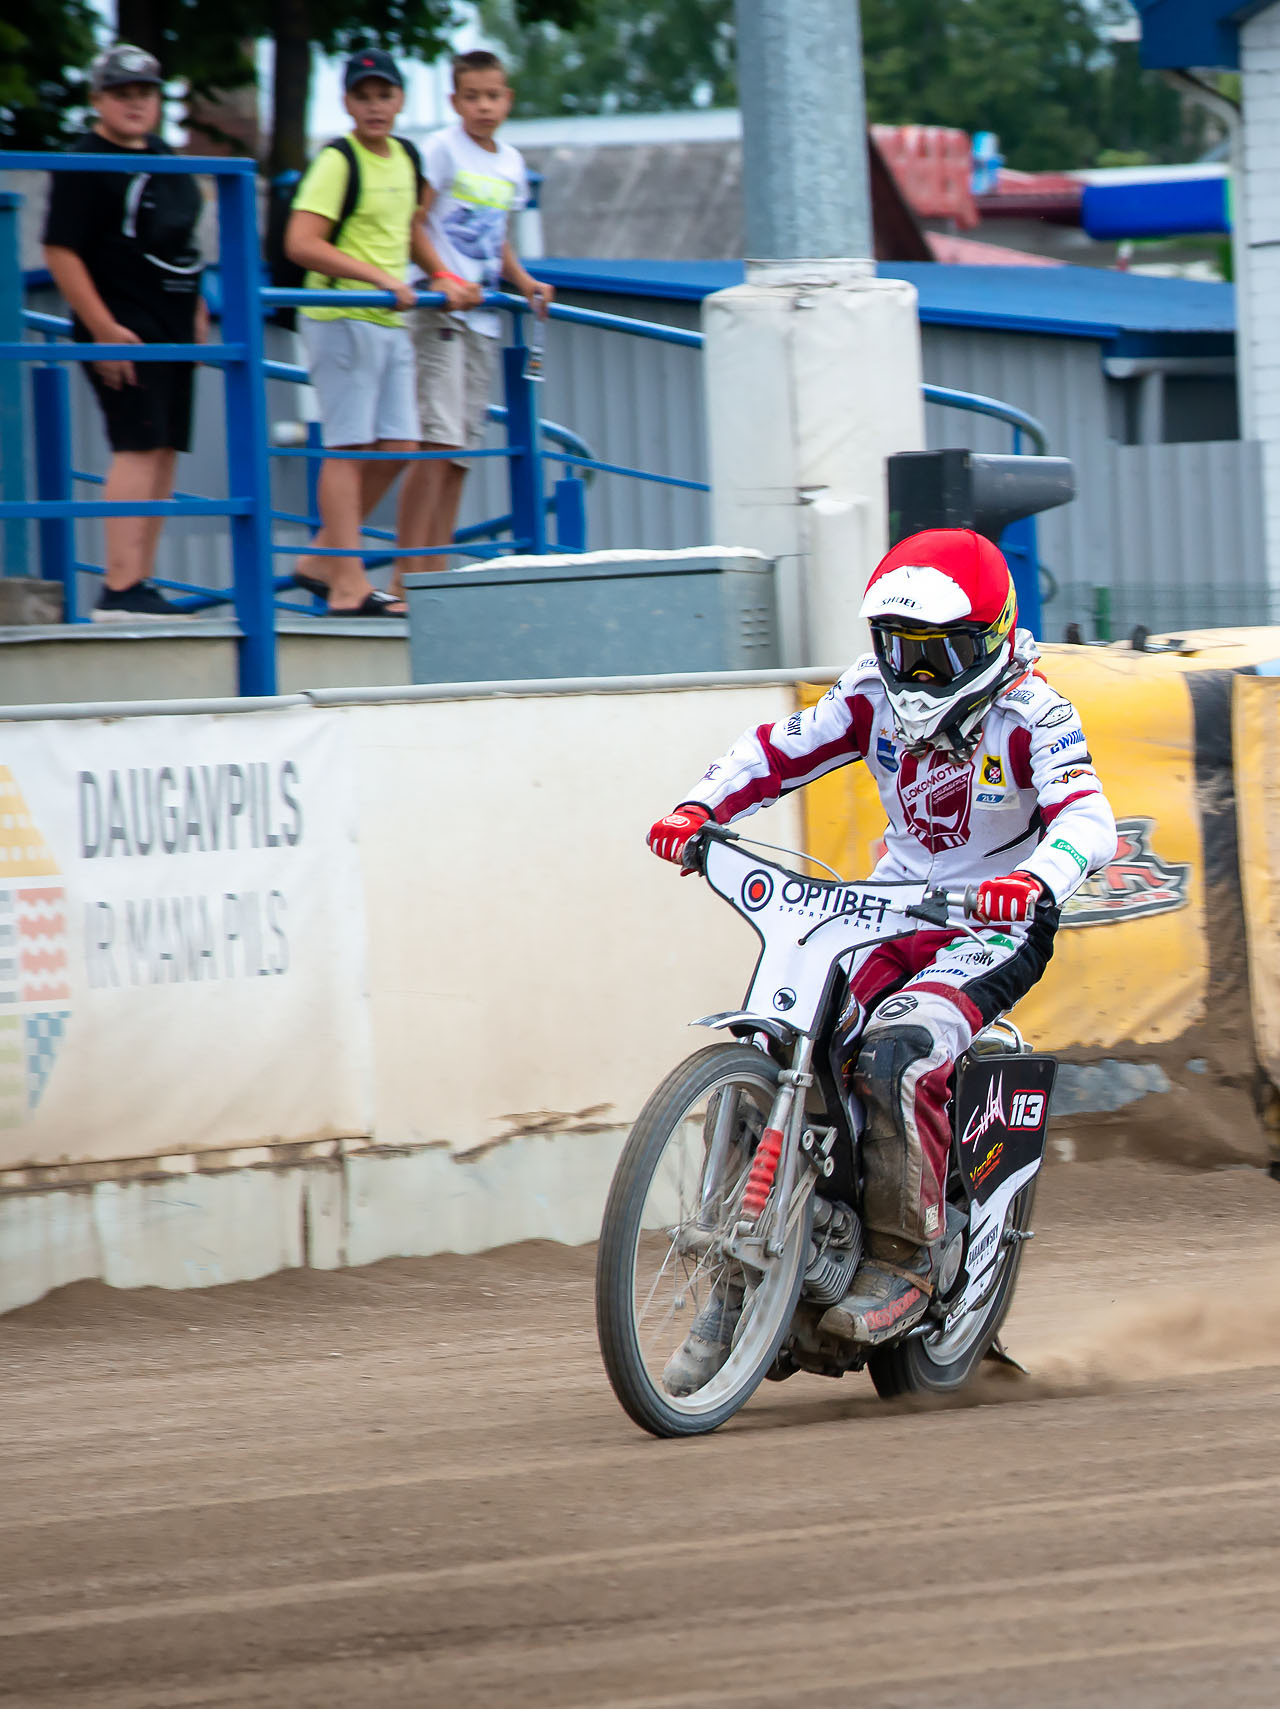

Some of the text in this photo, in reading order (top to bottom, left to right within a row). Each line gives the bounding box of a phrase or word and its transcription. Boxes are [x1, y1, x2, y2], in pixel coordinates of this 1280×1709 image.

[78, 760, 303, 859] DAUGAVPILS
[779, 905, 836, 921] SPORT
[781, 880, 891, 924] OPTIBET
[222, 888, 290, 978] PILS
[1009, 1094, 1045, 1127] 113
